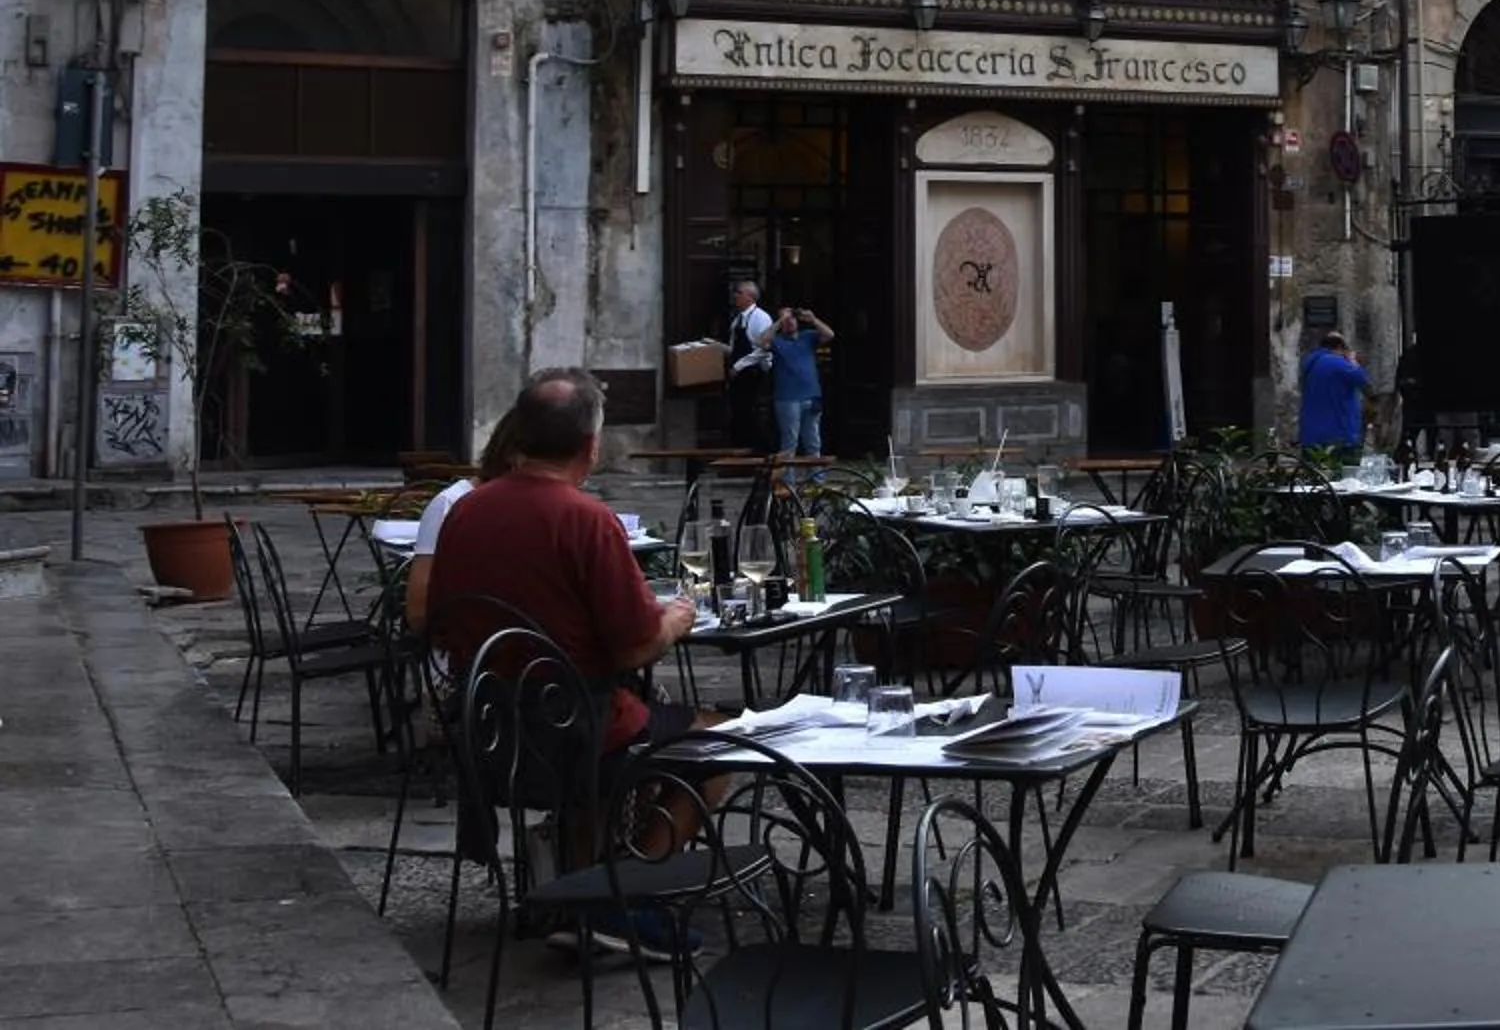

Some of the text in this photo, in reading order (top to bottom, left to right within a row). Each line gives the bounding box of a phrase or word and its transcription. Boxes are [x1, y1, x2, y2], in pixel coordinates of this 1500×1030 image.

[713, 29, 838, 69] Antica
[846, 34, 1037, 76] Focacceria
[1083, 46, 1247, 86] Francesco
